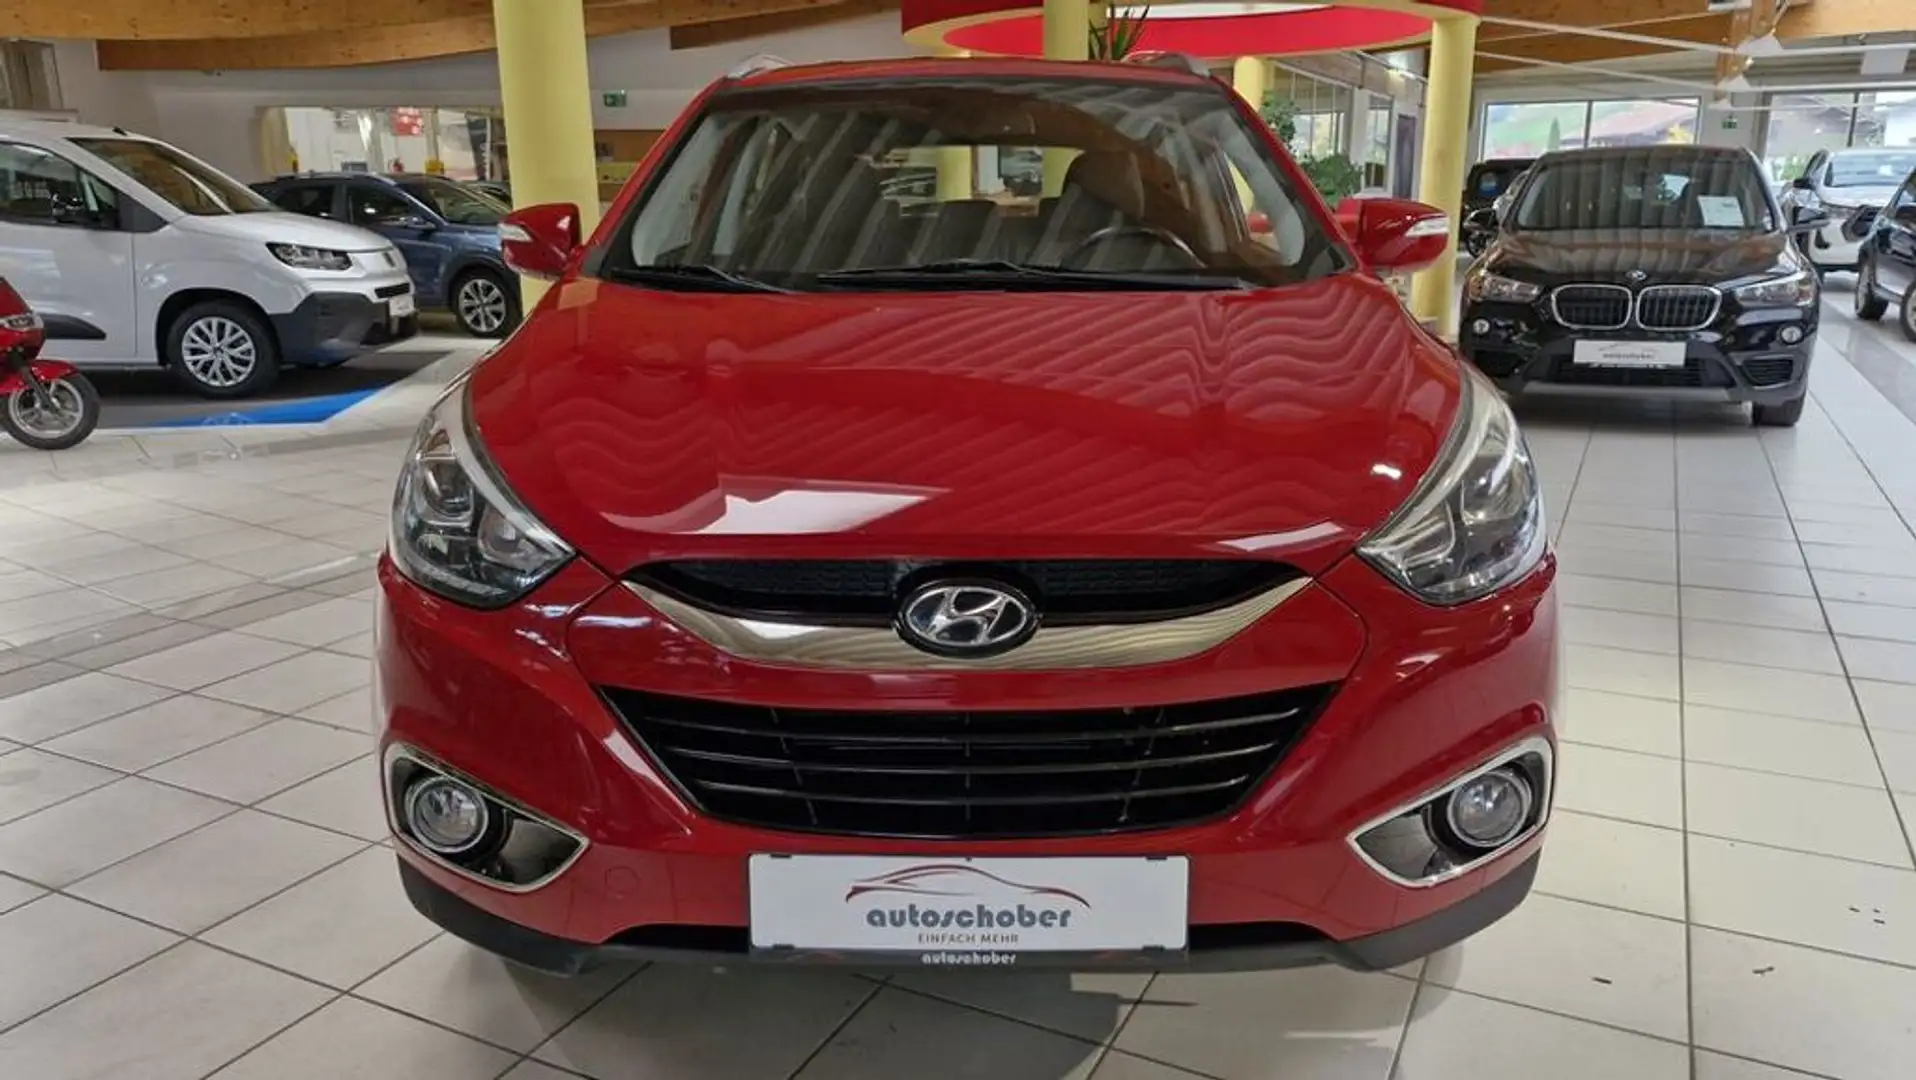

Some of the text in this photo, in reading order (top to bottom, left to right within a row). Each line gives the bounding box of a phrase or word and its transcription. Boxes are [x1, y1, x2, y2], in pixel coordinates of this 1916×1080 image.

[866, 904, 1072, 928] autoschober
[918, 932, 1019, 944] EINFACH MEHR
[920, 951, 1017, 965] autoschober
